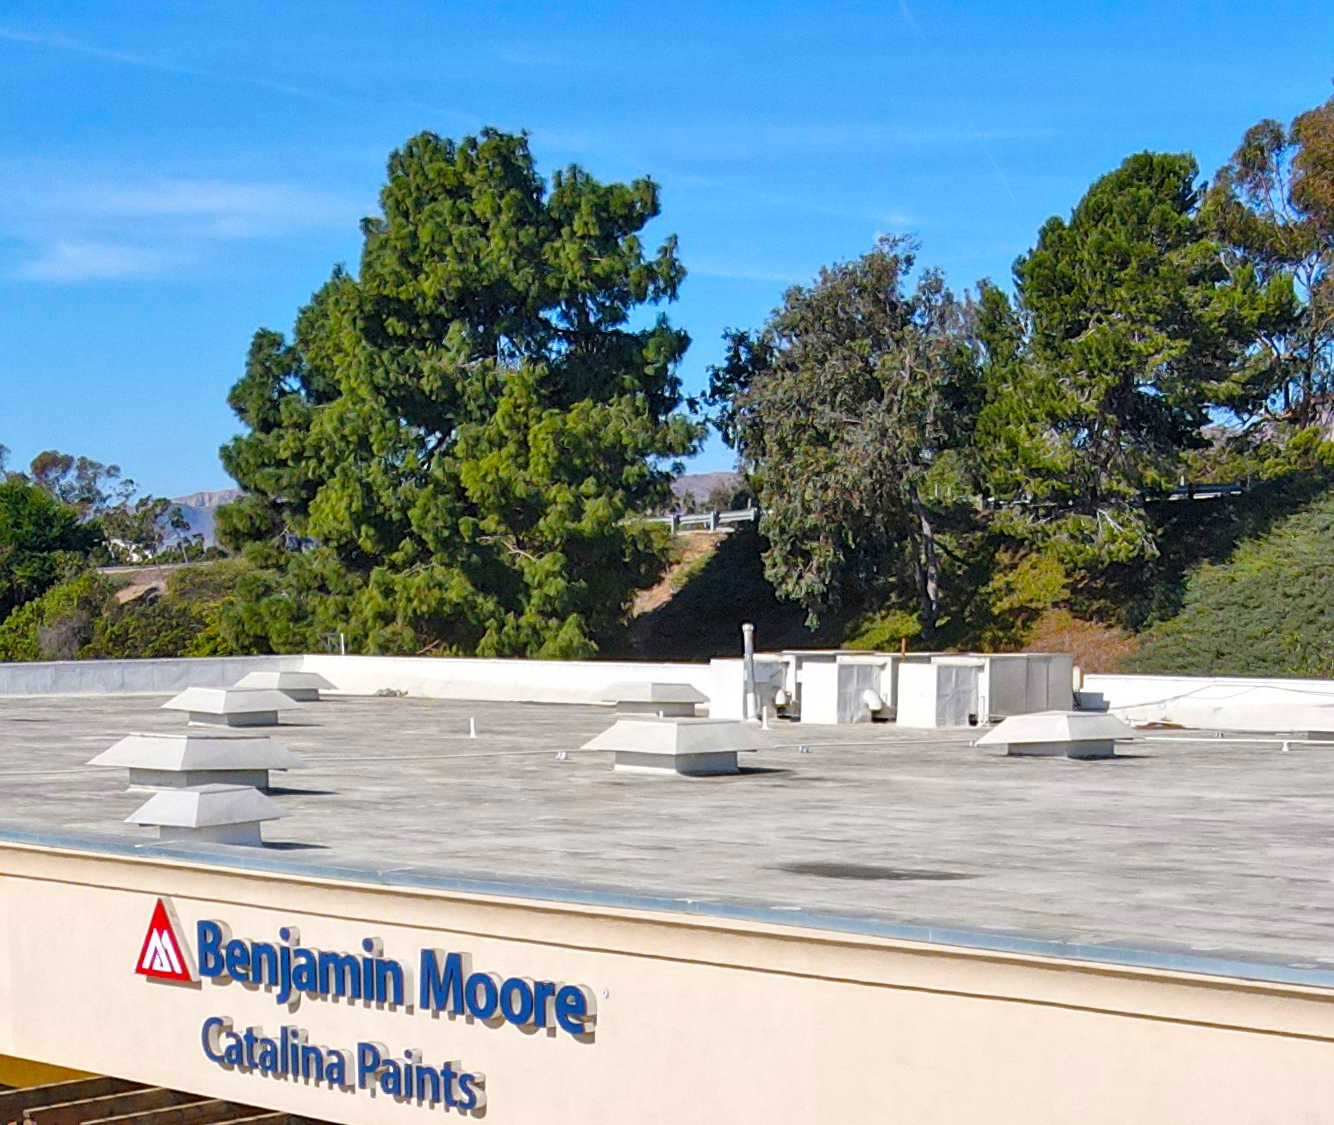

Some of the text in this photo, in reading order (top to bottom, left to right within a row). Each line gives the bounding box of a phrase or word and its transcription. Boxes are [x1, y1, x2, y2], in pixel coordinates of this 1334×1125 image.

[196, 920, 592, 1035] Benjamin Moore
[201, 1016, 481, 1111] Catalina Paints
